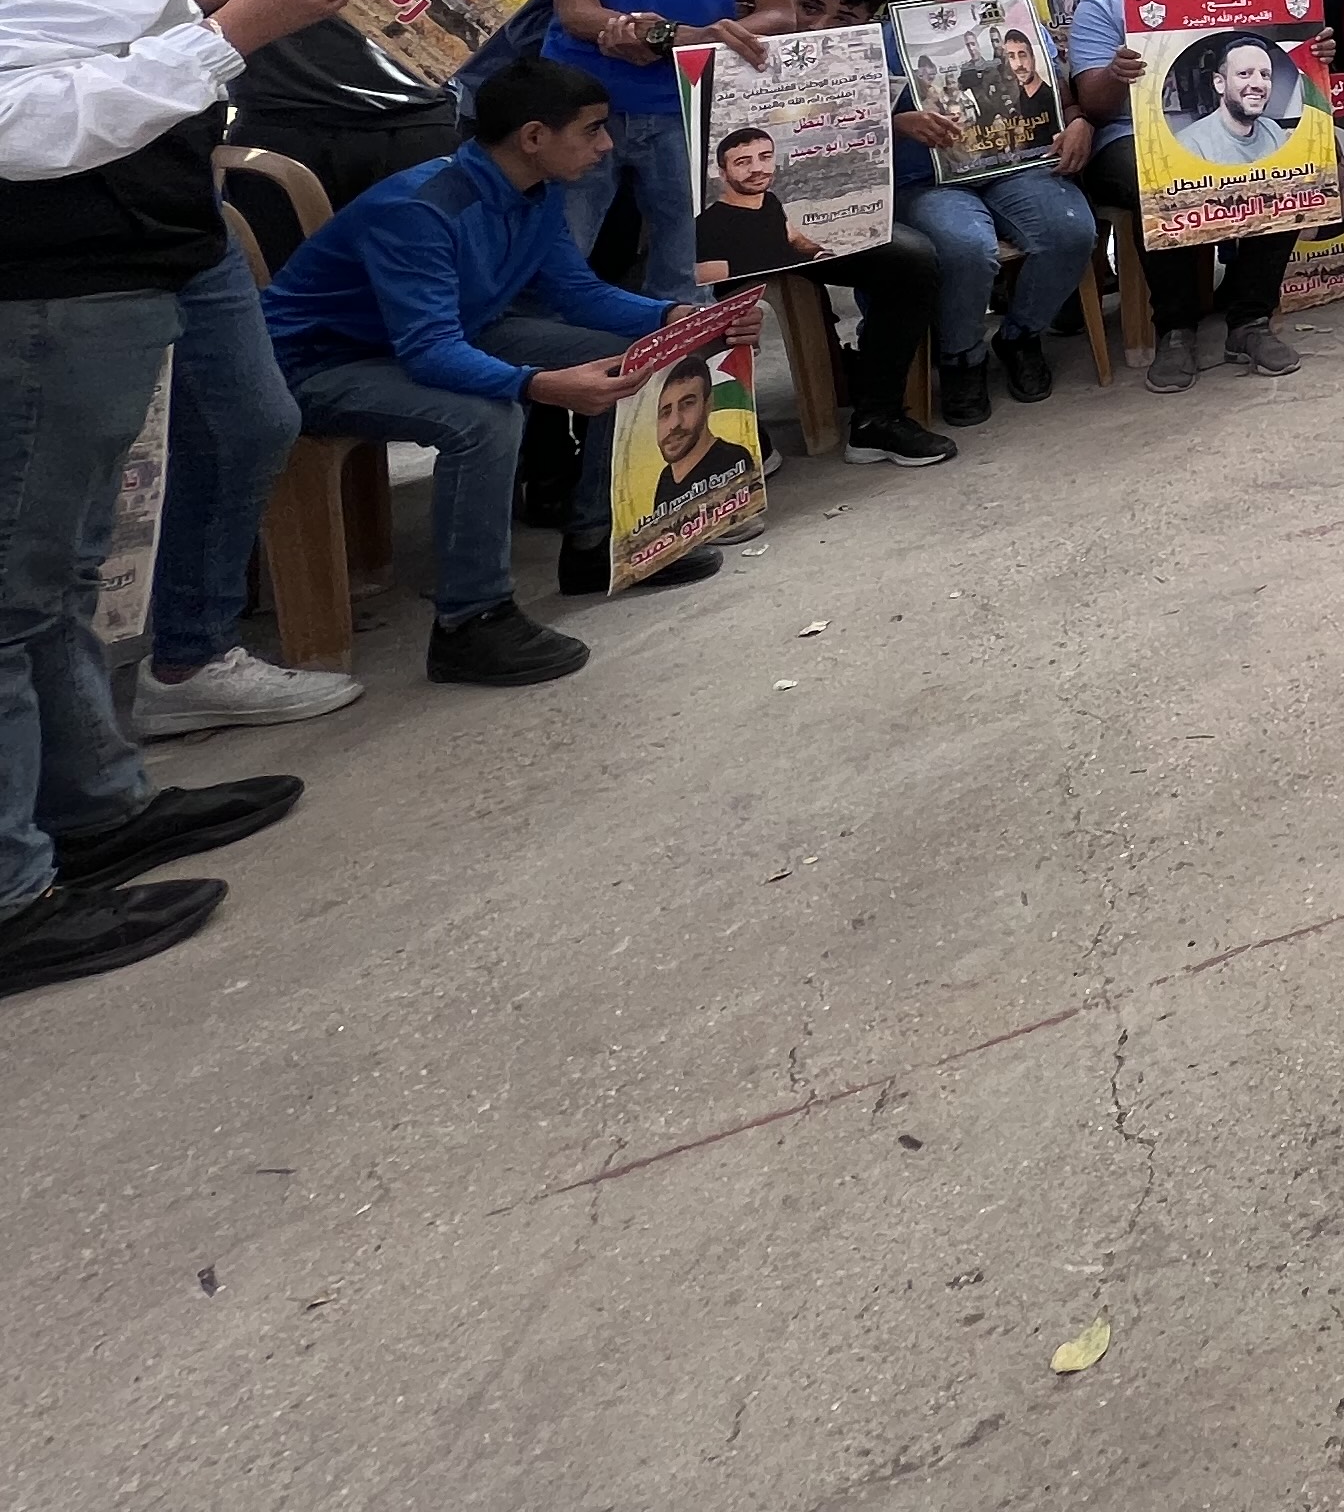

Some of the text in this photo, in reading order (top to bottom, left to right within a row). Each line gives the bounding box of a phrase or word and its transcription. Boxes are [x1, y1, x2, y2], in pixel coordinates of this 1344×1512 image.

[1166, 162, 1315, 196] الحرية للأسير البطل
[1161, 187, 1327, 237] ظافر الريماوي
[708, 459, 747, 488] الحرية
[630, 486, 750, 568] ناصر أبو حميد
